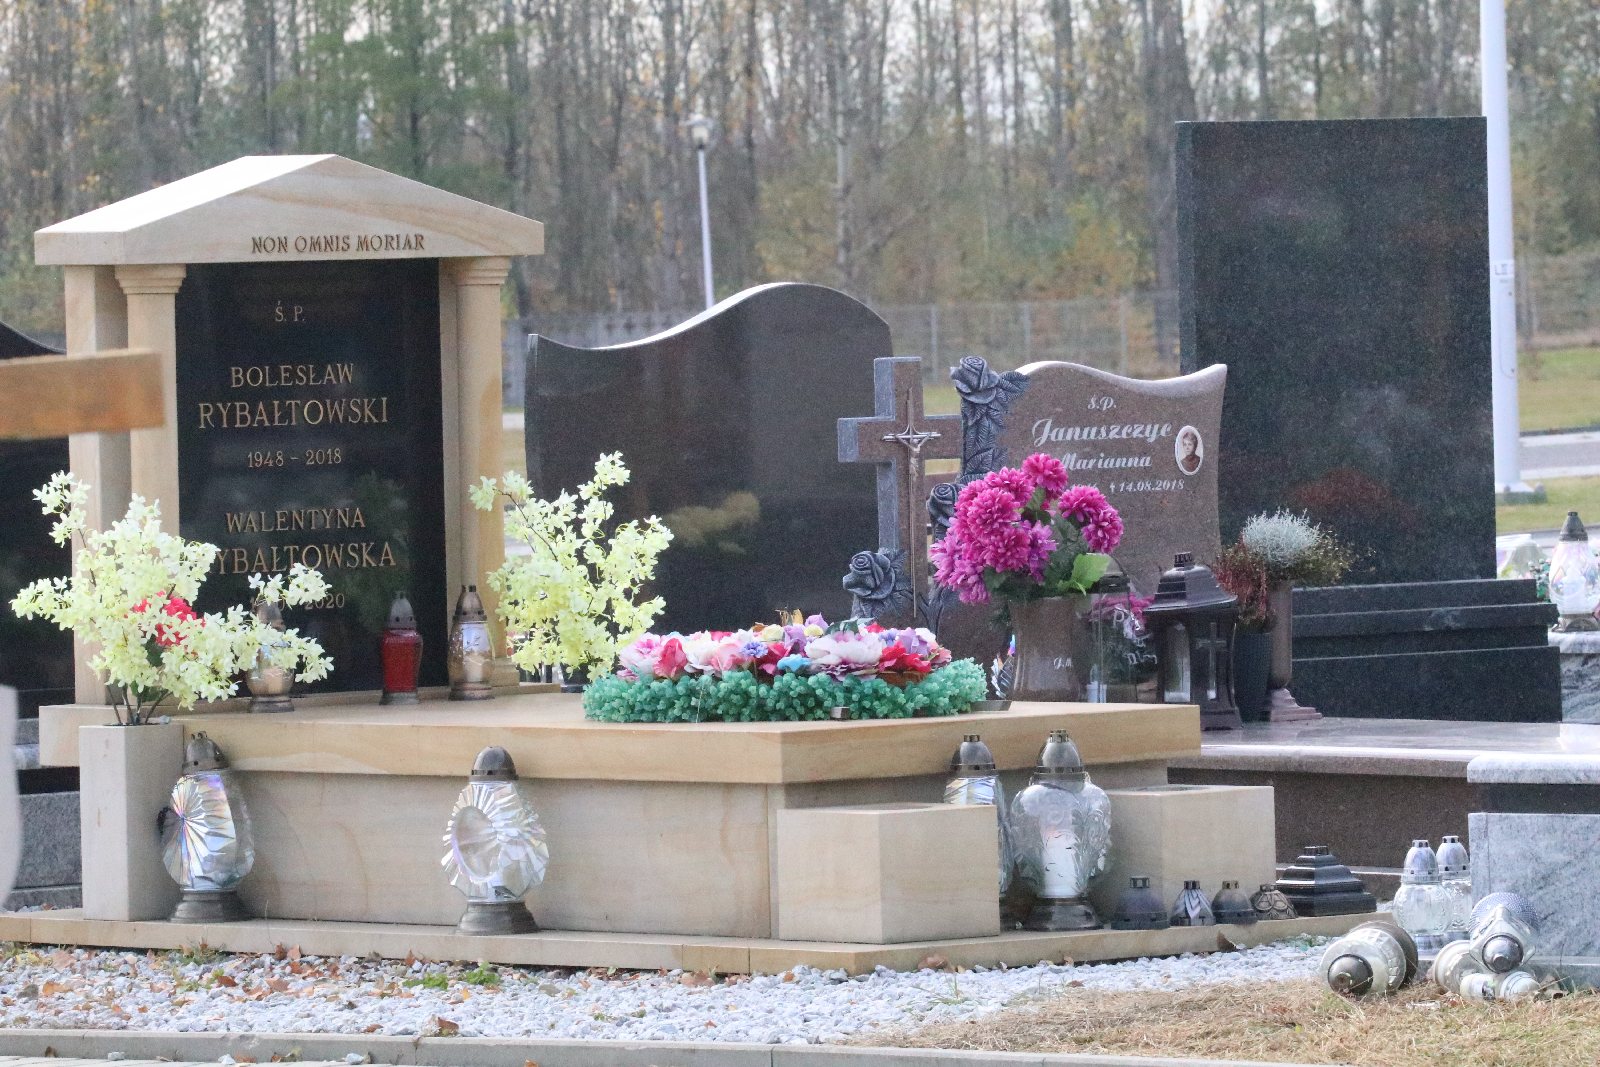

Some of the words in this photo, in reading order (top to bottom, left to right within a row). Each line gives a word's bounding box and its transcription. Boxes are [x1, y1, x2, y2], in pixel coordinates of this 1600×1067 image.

[251, 236, 288, 254] NON
[294, 235, 351, 253] OMNIS
[356, 233, 425, 251] MORIAR
[293, 305, 305, 322] P.
[230, 363, 354, 388] BOLESŁAW
[199, 397, 388, 429] RYBAŁTOWSKI
[1031, 419, 1173, 447] Januszczyc
[247, 451, 284, 468] 1948
[305, 448, 342, 465] 2018
[1061, 452, 1152, 471] Marianna
[1119, 478, 1185, 493] 14.08.2018
[226, 507, 366, 534] WALENTYNA
[209, 541, 396, 576] YBAŁTOWSKA
